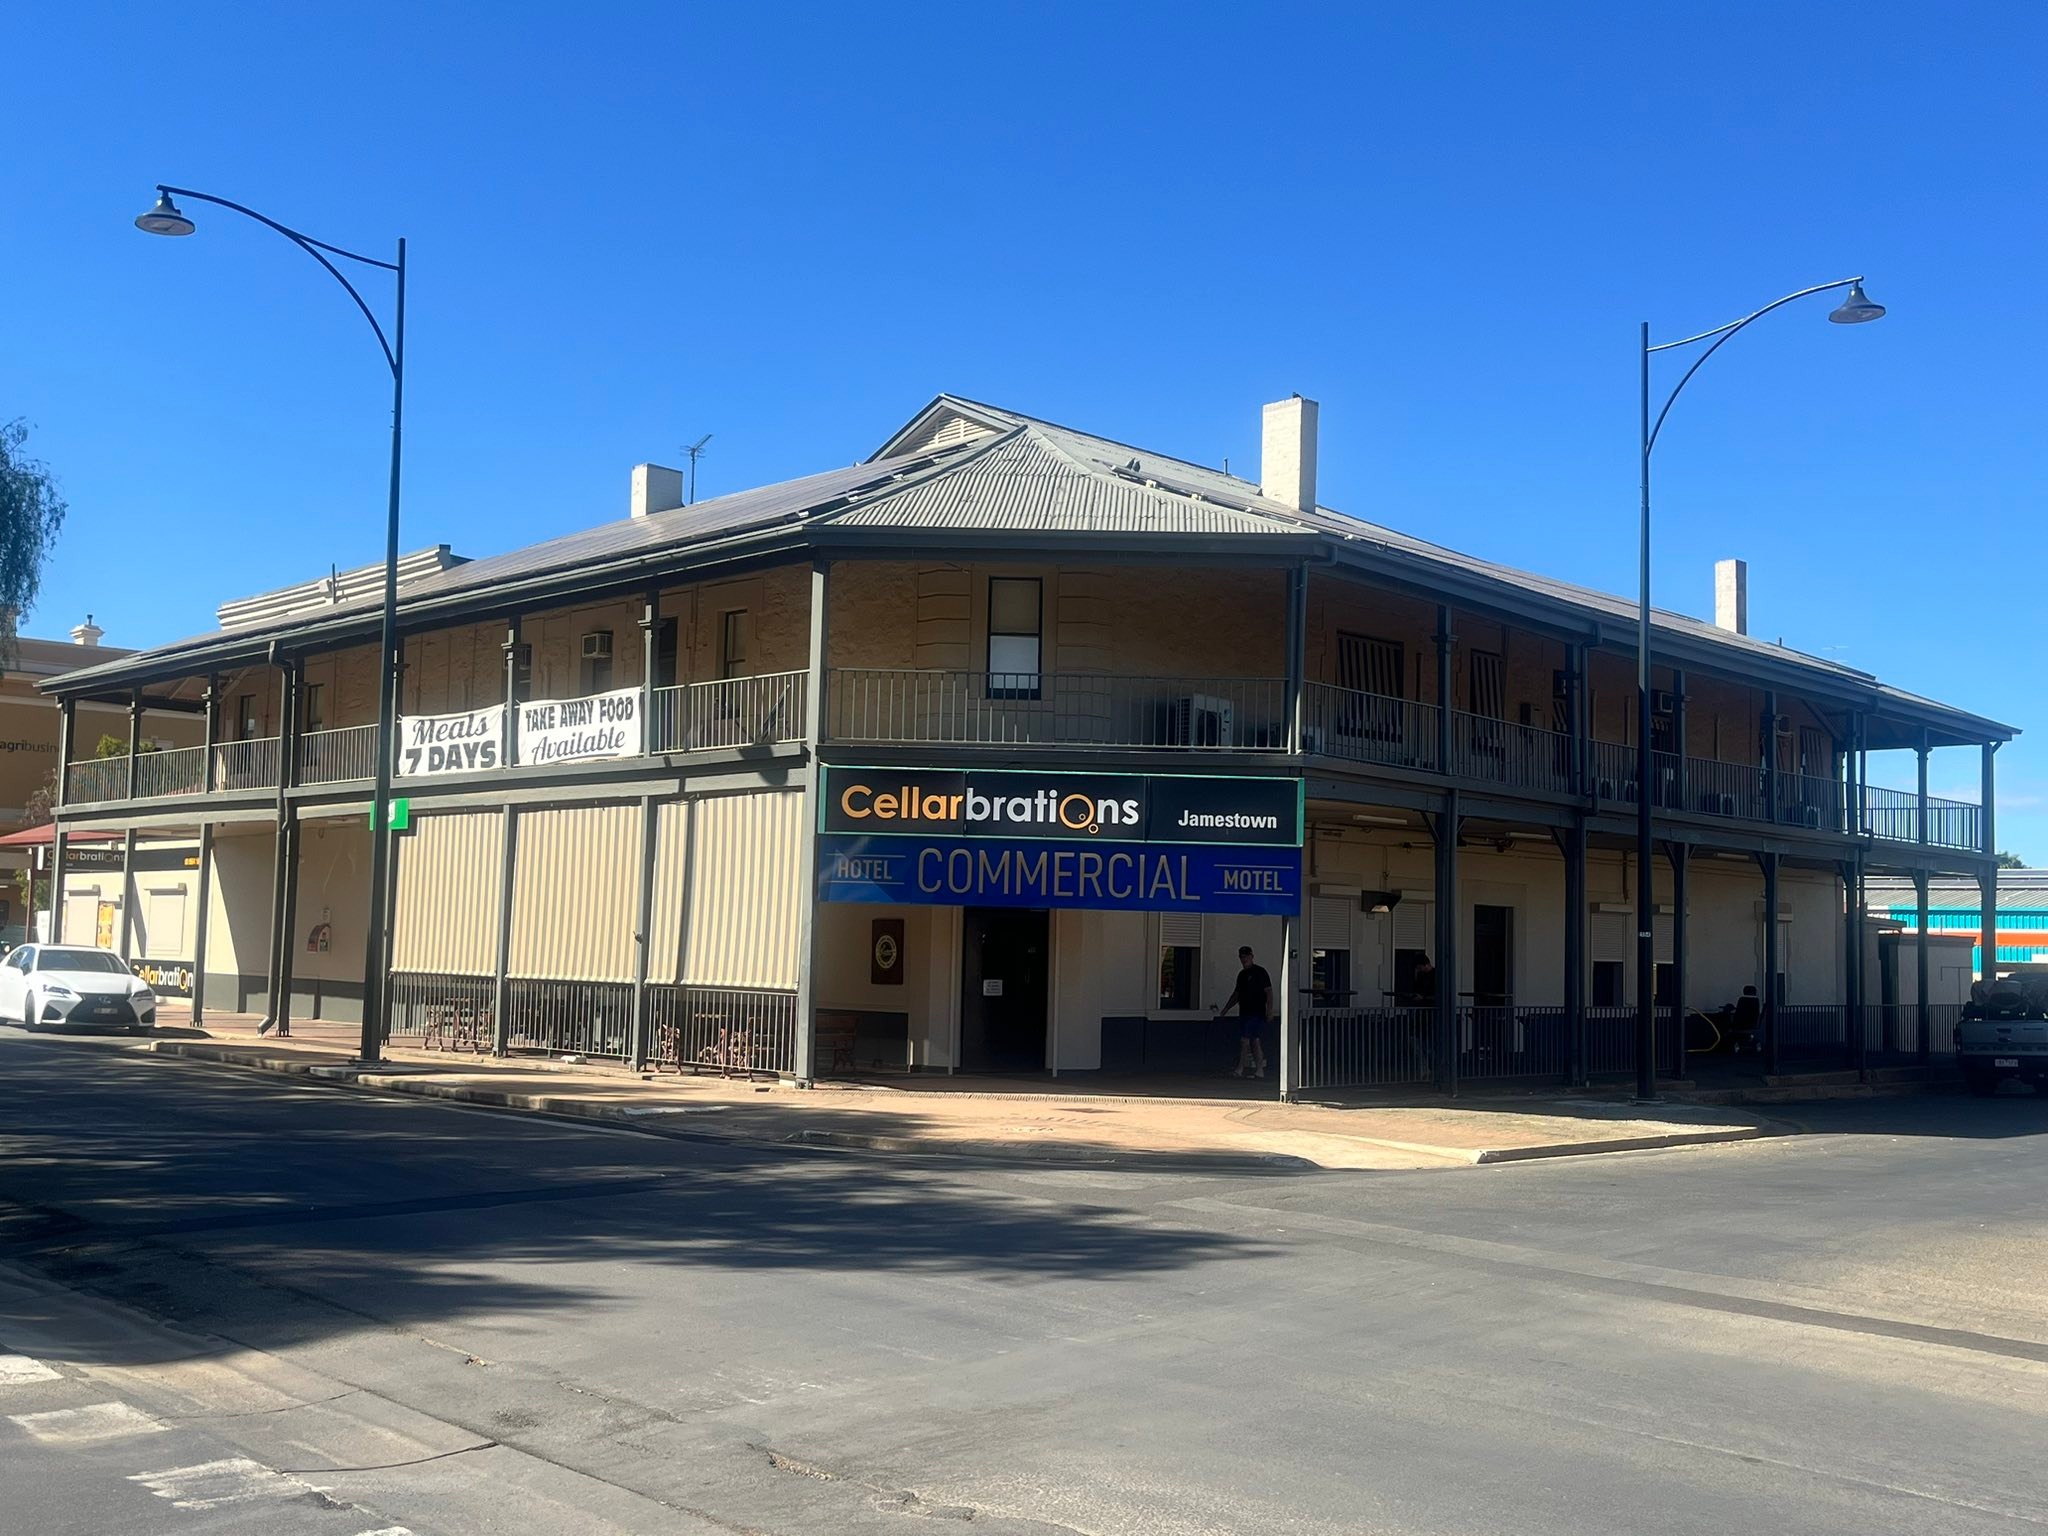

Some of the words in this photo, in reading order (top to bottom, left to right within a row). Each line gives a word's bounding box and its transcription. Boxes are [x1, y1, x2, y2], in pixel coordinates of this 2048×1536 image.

[412, 713, 489, 746] Meals
[525, 705, 555, 732] TAKE
[560, 700, 594, 729] AWAY
[600, 696, 634, 724] FOOD
[0, 738, 60, 754] agribusin
[405, 748, 423, 774] 7
[428, 740, 496, 772] DAYS
[531, 726, 626, 765] Available
[1178, 809, 1278, 830] Jamestown
[837, 858, 893, 881] HOTEL
[917, 847, 1201, 901] COMMERCIAL
[1223, 868, 1283, 892] MOTEL
